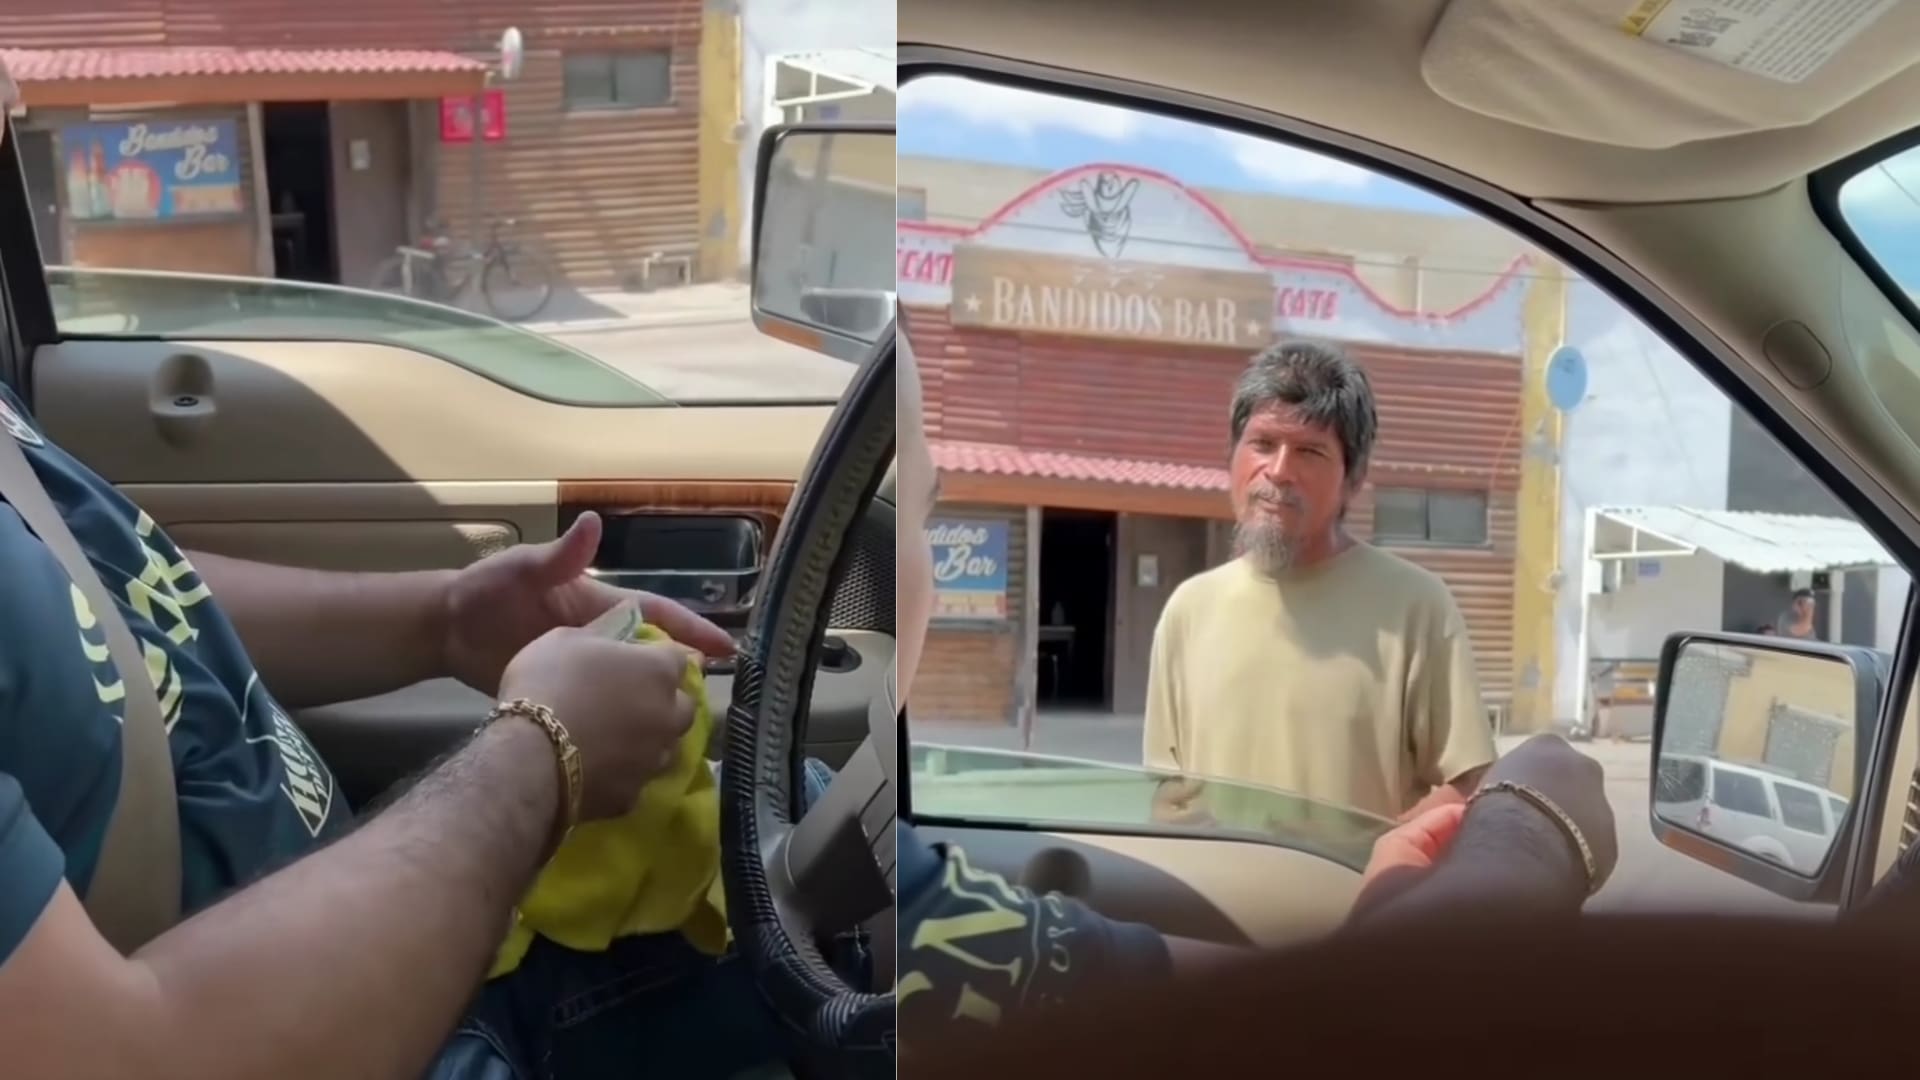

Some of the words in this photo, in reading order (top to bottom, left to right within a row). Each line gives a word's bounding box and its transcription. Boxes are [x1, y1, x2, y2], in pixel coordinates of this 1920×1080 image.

[174, 144, 230, 180] Bar
[897, 247, 954, 284] CAT
[991, 275, 1163, 336] BANDIDOS
[1174, 296, 1238, 344] BAR
[934, 543, 998, 582] Bar
